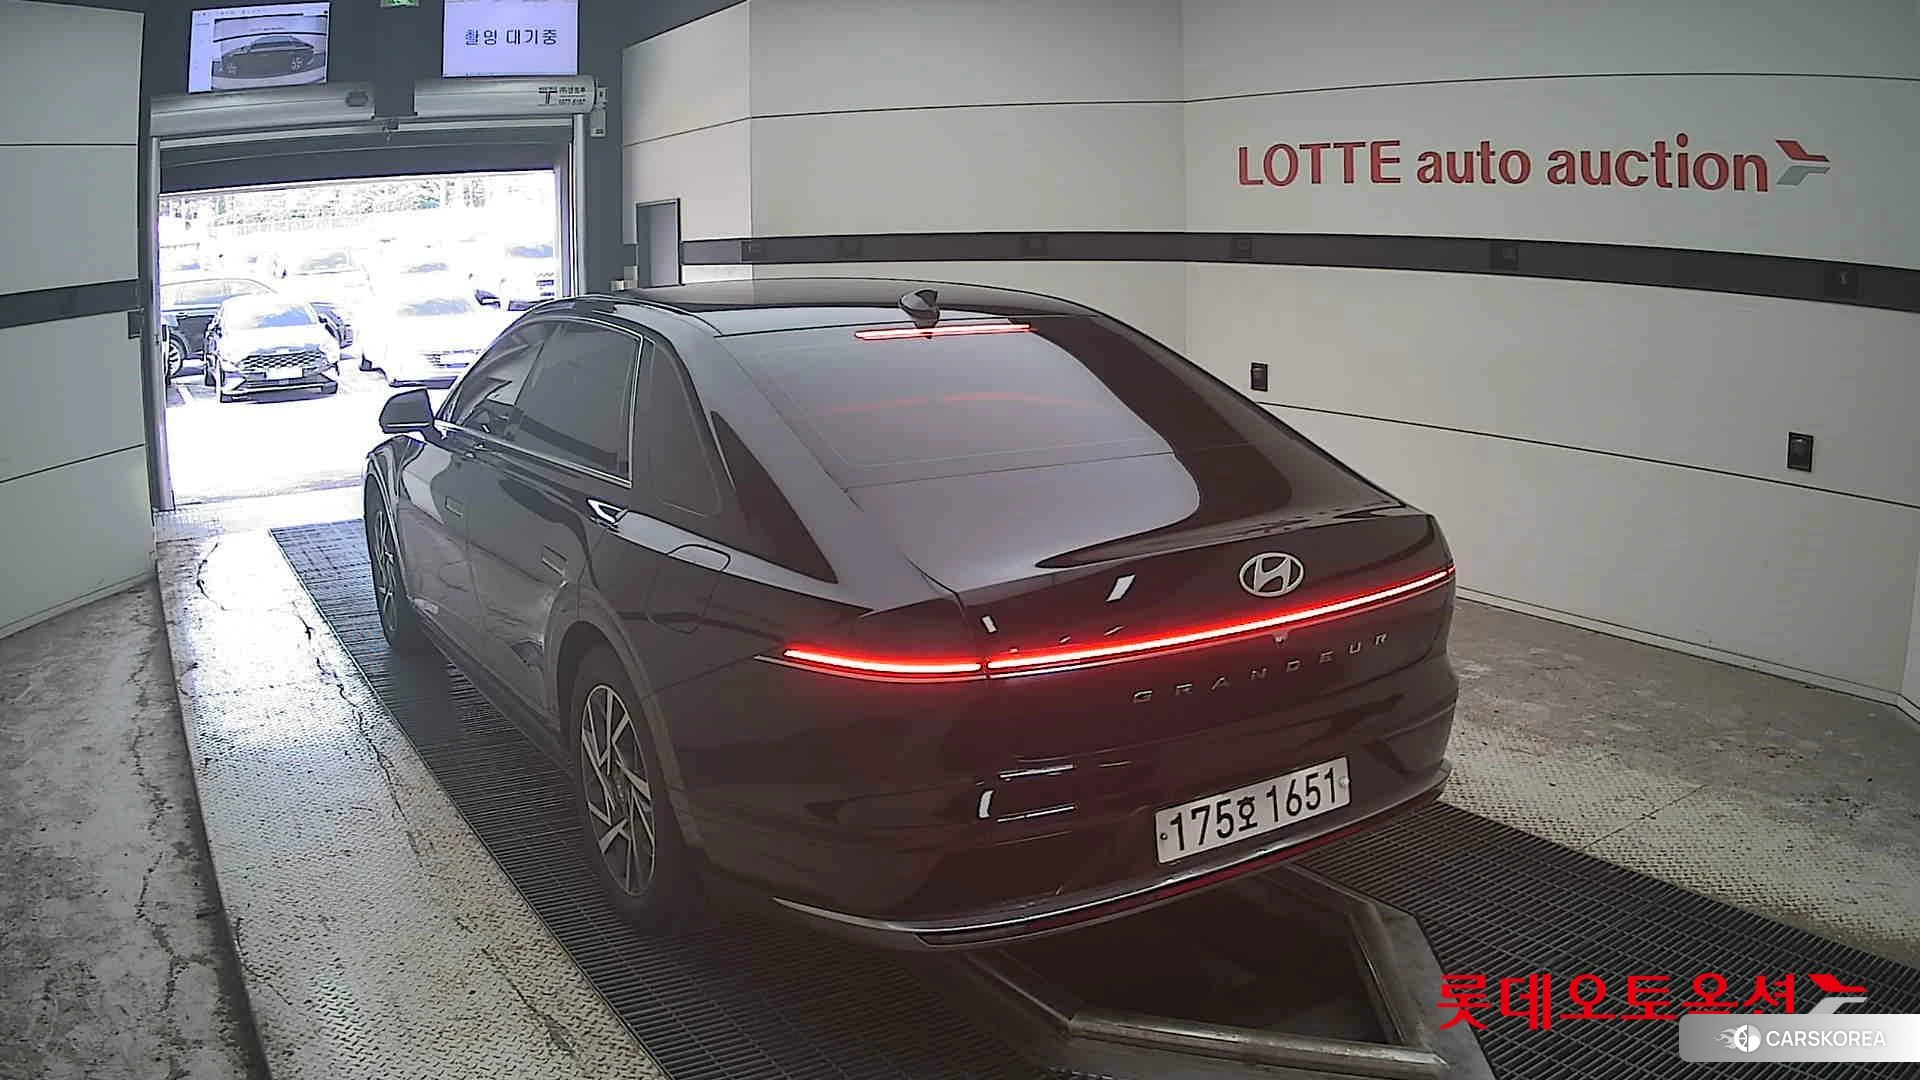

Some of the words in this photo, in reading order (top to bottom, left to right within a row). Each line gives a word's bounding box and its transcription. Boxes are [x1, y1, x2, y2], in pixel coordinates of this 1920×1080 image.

[505, 28, 557, 46] 대기중
[1238, 140, 1401, 187] LOTTE
[1416, 140, 1532, 185] auto
[1546, 132, 1768, 193] auction
[1132, 632, 1388, 703] GRANDEUR
[1265, 767, 1337, 823] 1651
